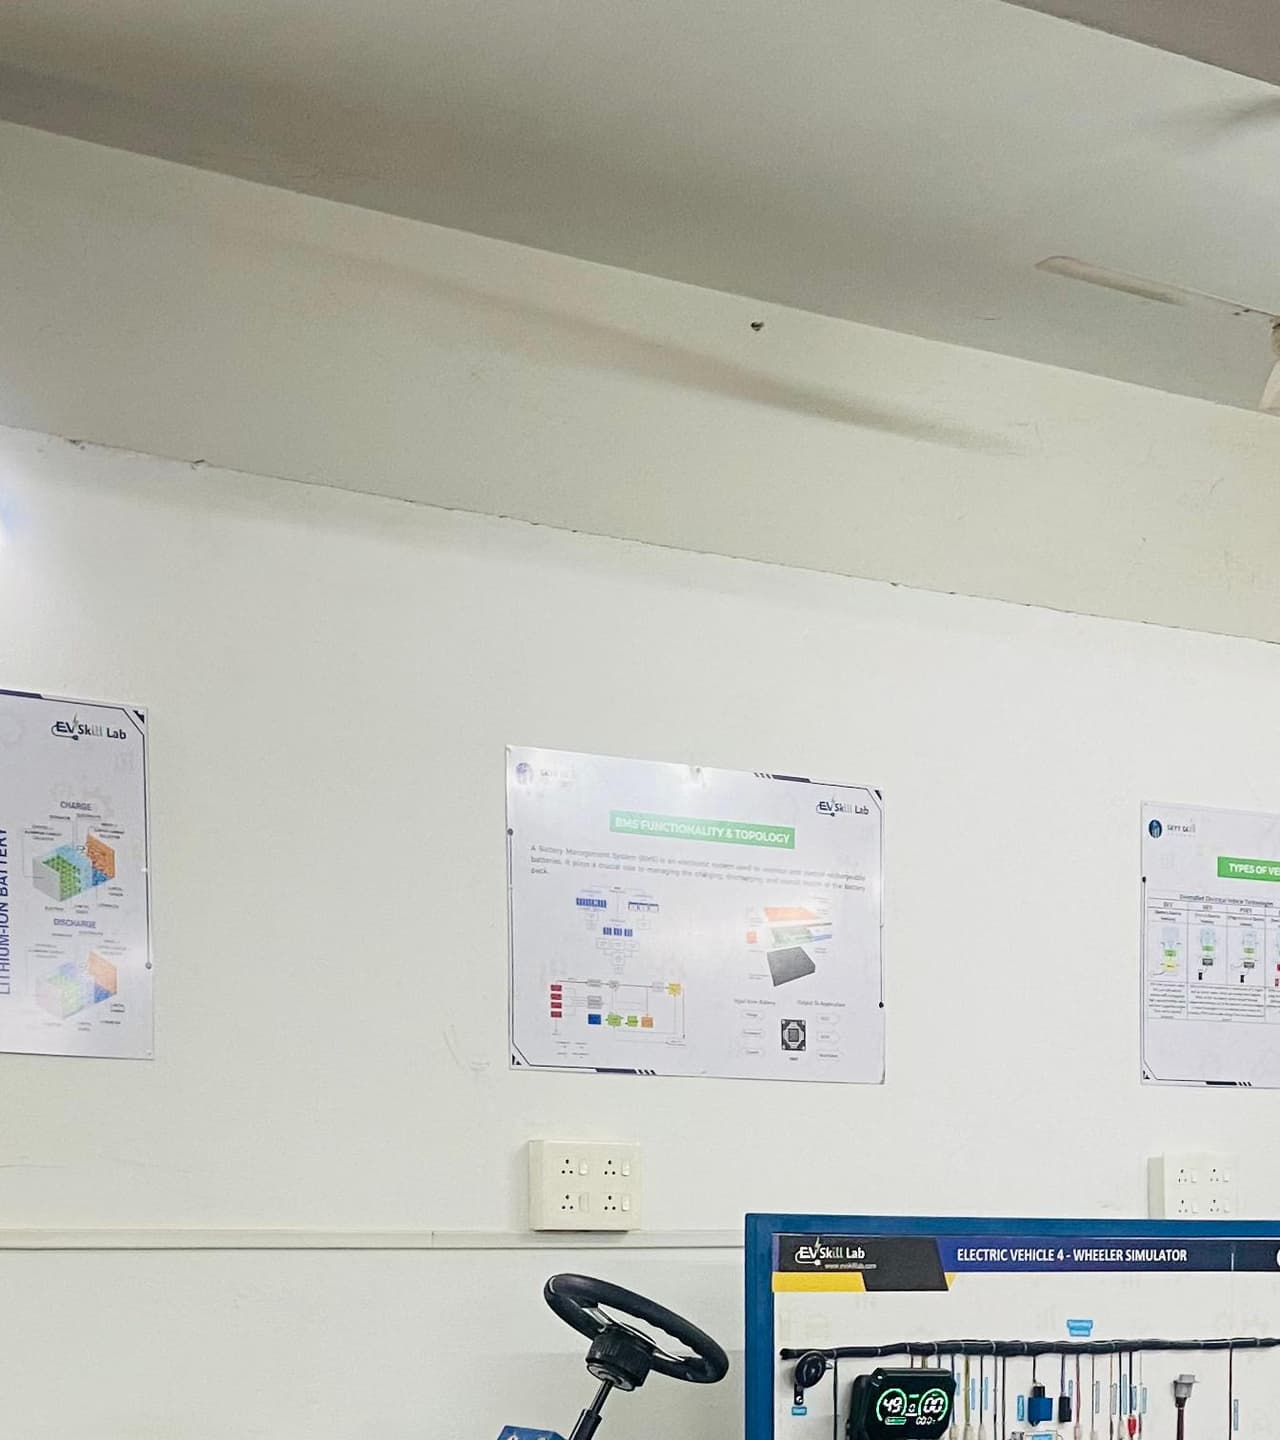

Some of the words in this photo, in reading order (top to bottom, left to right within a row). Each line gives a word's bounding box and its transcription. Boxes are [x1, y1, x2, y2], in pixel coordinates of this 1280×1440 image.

[107, 727, 126, 740] Lab
[60, 801, 92, 811] CHARGE
[855, 805, 869, 815] Lab
[1229, 863, 1255, 873] TYPES
[1256, 866, 1267, 874] OF
[53, 918, 96, 929] DISCHARGE
[799, 1247, 818, 1258] EV
[820, 1247, 844, 1259] Skill
[846, 1247, 865, 1259] Lab
[957, 1249, 1007, 1261] ELECTRIC
[1011, 1249, 1054, 1261] VEHICLE
[1057, 1249, 1064, 1261] 4
[1073, 1249, 1123, 1261] WHEELER
[1126, 1249, 1187, 1261] SIMULATOR
[883, 1397, 902, 1413] 49
[923, 1397, 944, 1413] 00
